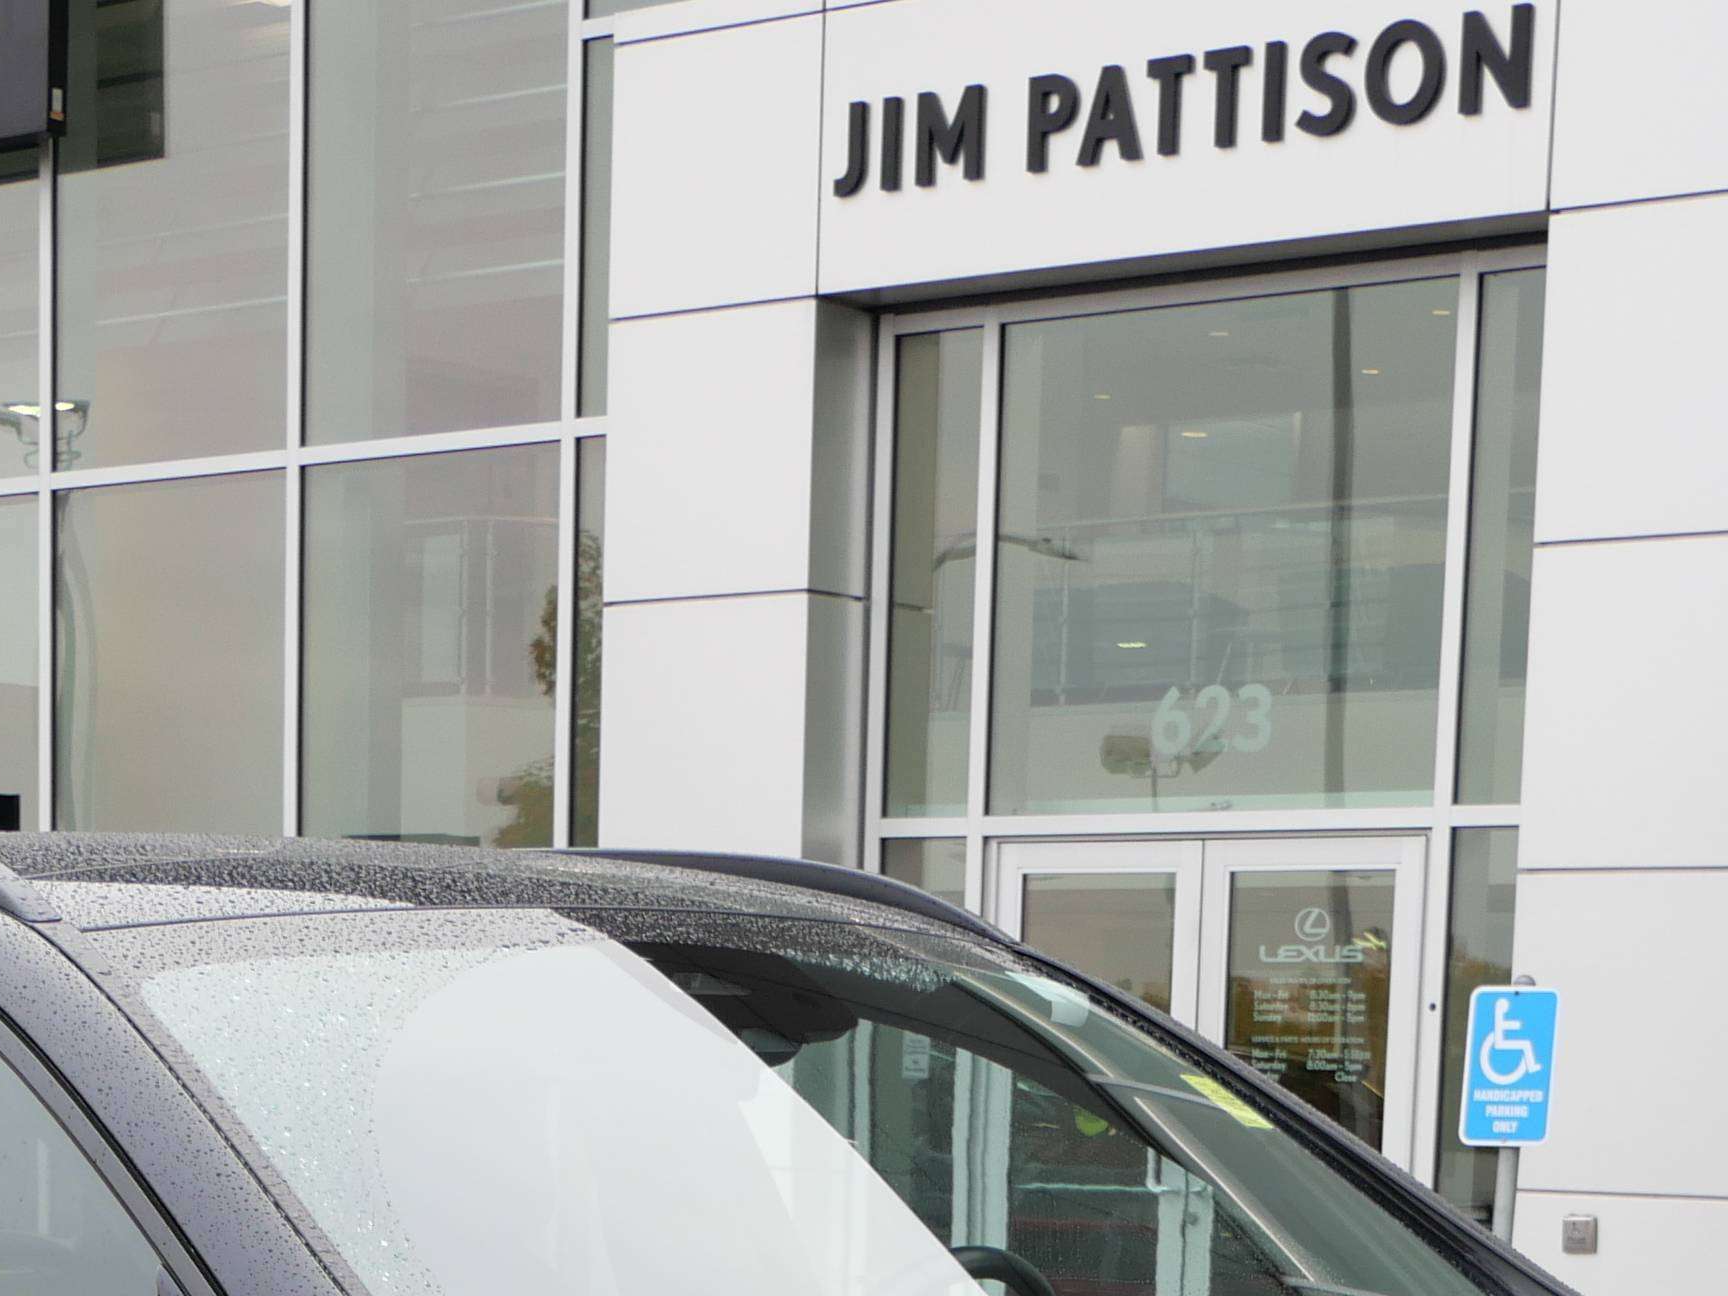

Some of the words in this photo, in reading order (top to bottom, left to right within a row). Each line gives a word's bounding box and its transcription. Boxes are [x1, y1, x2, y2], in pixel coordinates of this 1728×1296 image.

[833, 83, 989, 199] JIM
[1026, 2, 1536, 175] PATTISON
[1151, 683, 1272, 755] 623
[1259, 945, 1365, 963] LEXUS
[1473, 1089, 1544, 1103] HANDICAPPED
[1485, 1105, 1529, 1118] PARKING
[1492, 1120, 1519, 1133] ONLY
